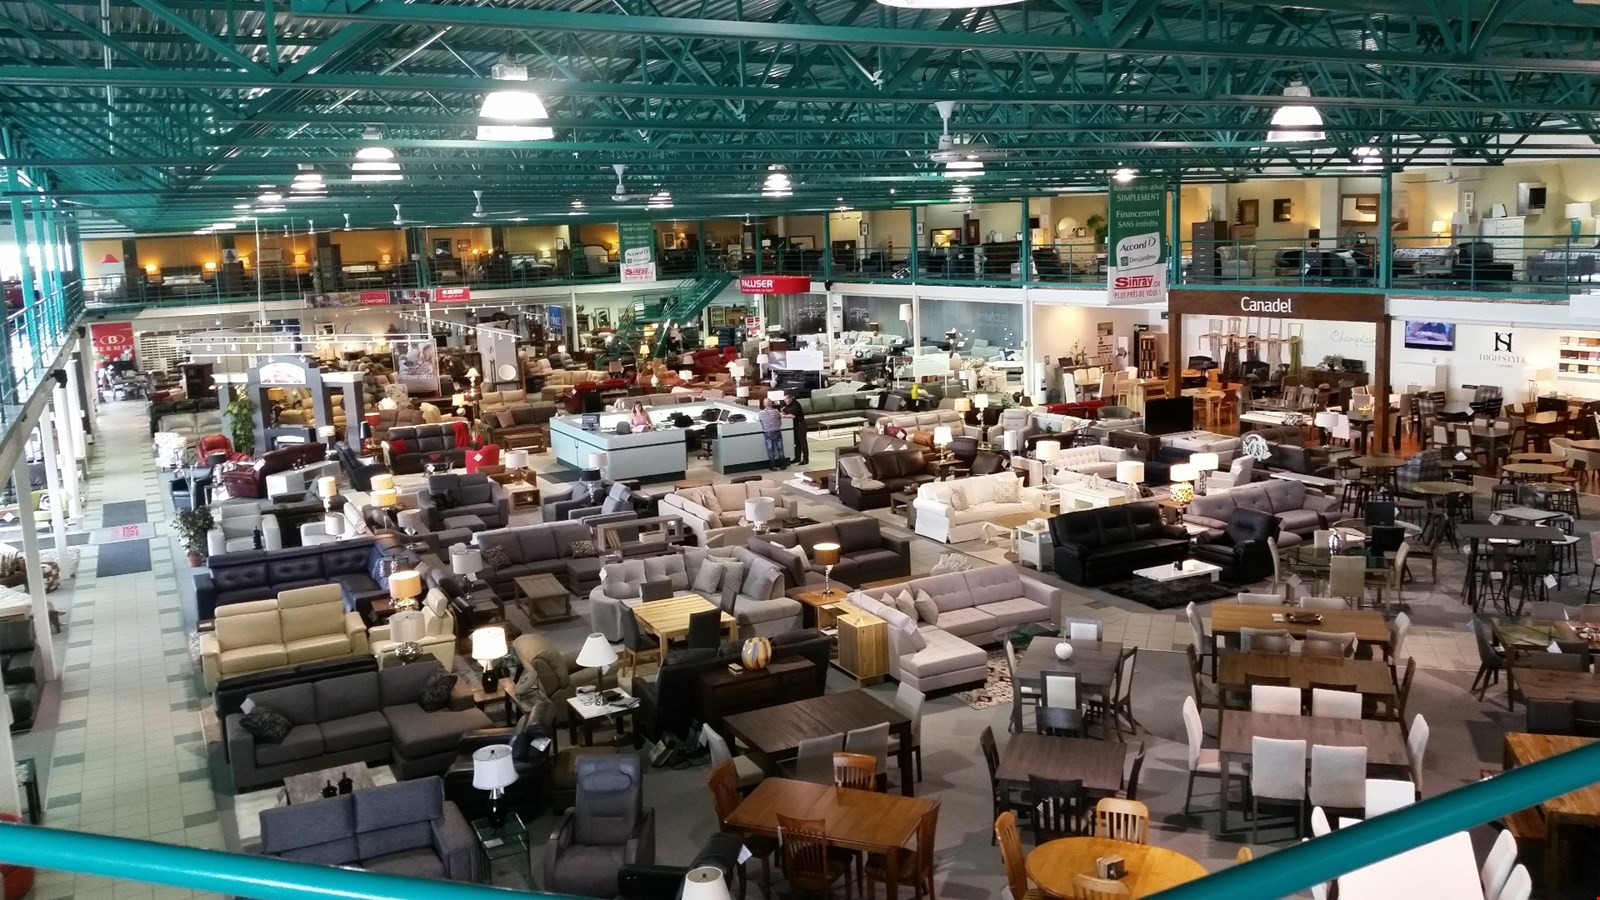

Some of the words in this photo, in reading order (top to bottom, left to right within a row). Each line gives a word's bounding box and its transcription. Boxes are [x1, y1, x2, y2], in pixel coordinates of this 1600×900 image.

[1116, 193, 1160, 202] SIMPLEMENT
[1116, 210, 1160, 218] Financement
[1120, 239, 1147, 252] Accord
[1114, 291, 1126, 299] PLUS
[1240, 296, 1292, 313] Canadel
